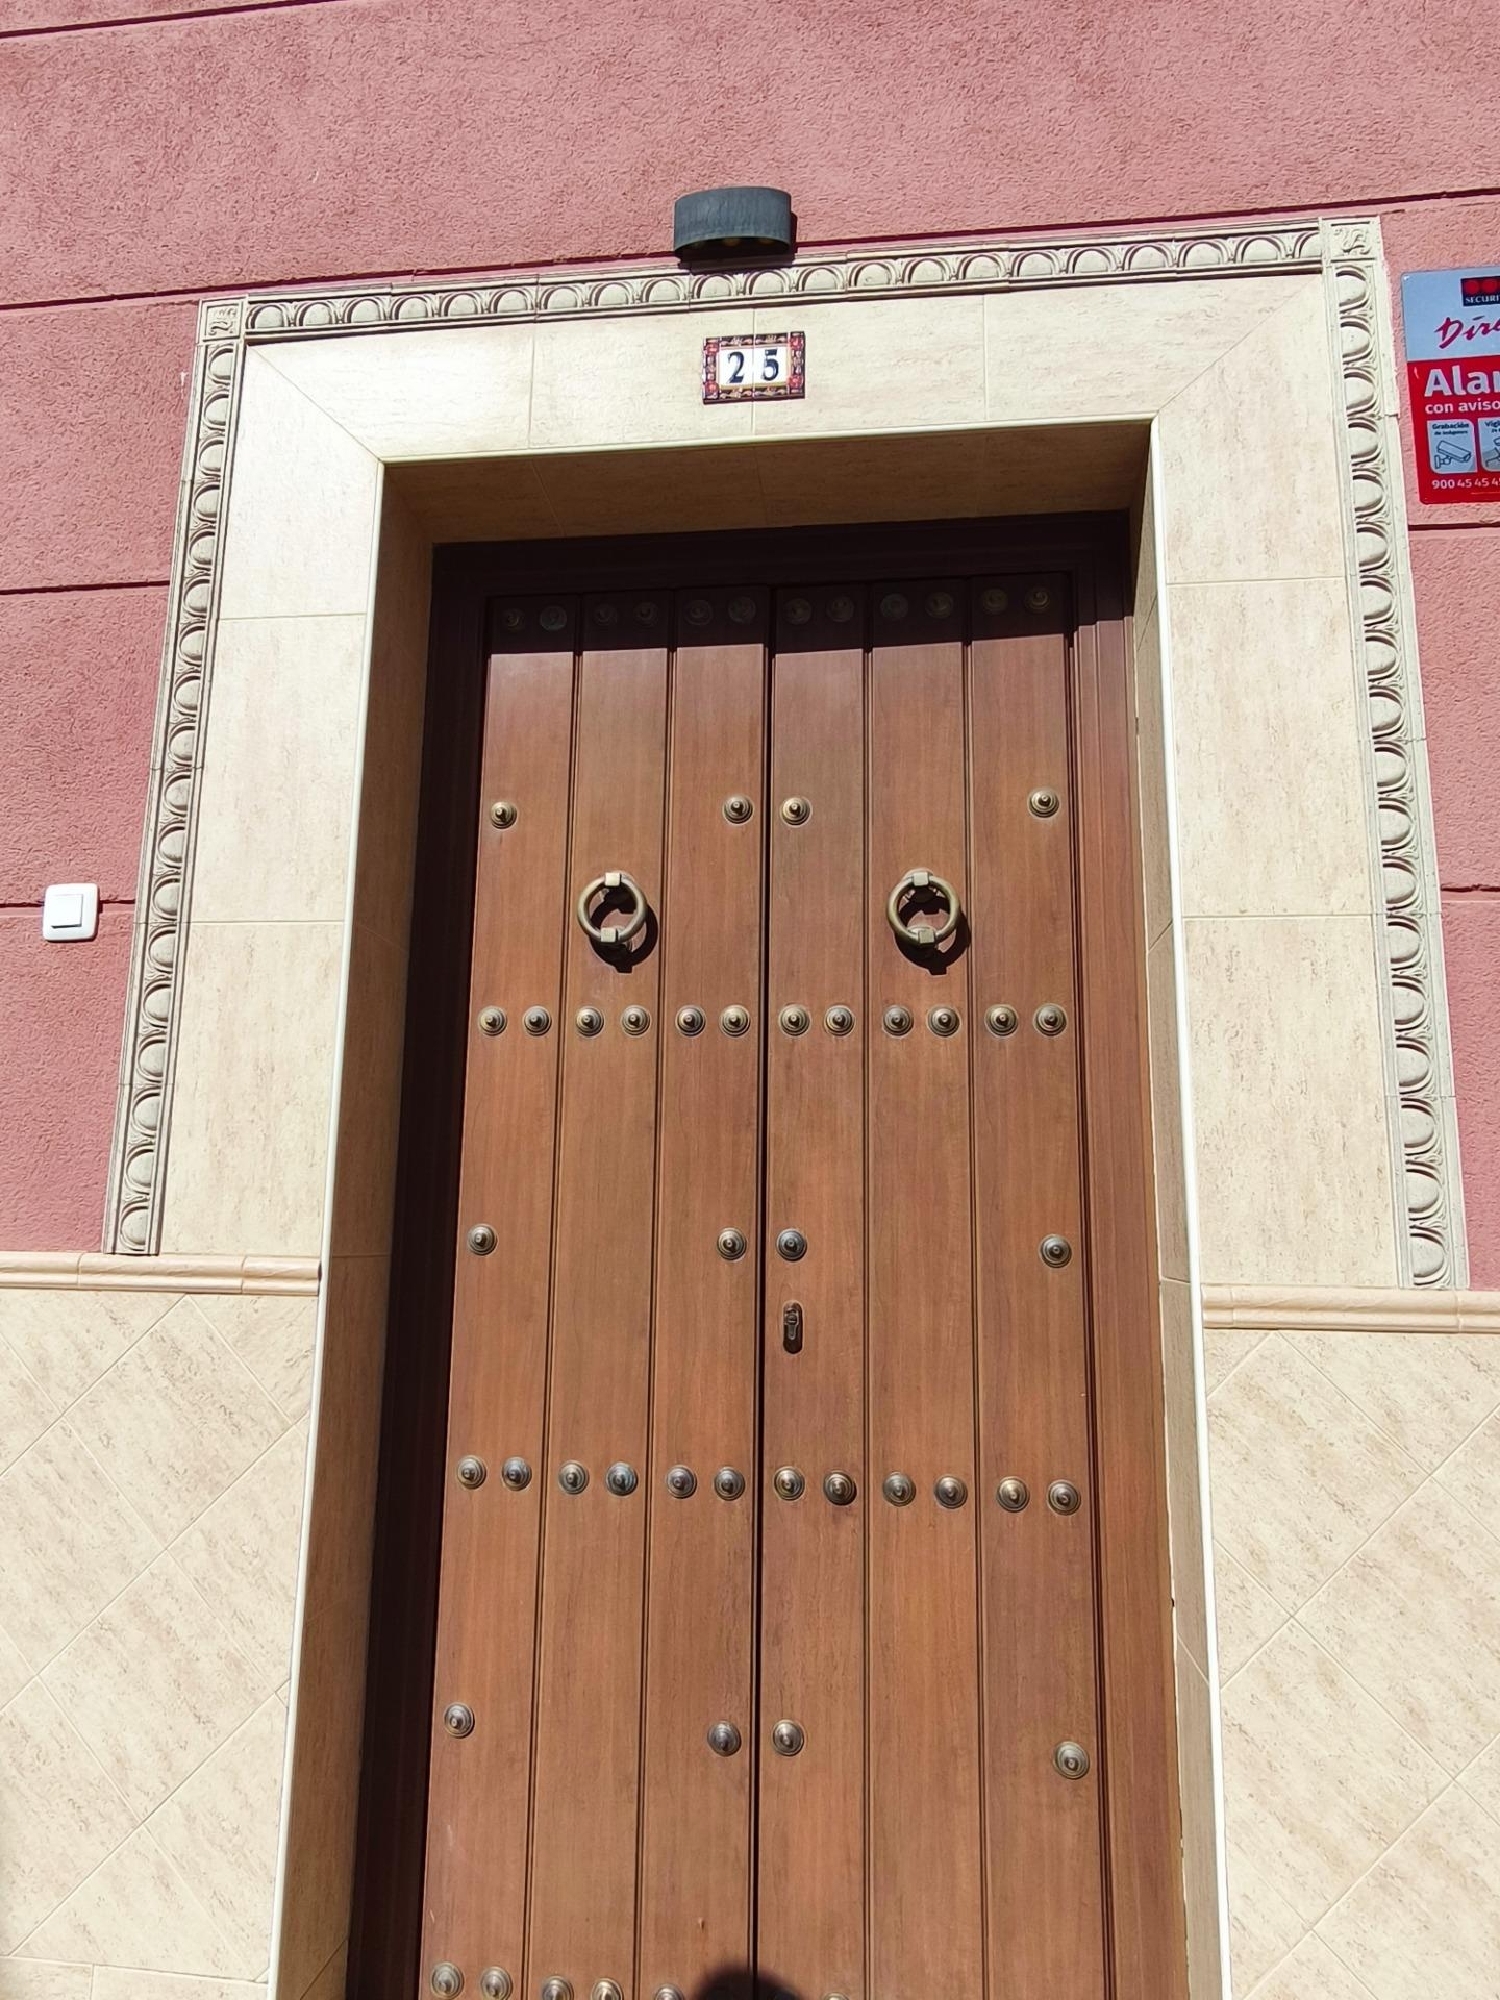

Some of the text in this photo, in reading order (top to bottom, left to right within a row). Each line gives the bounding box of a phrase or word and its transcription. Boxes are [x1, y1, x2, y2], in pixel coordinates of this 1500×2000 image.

[727, 349, 779, 384] 25
[1425, 398, 1500, 414] con aviso
[1432, 477, 1500, 489] 900 45 45 4
